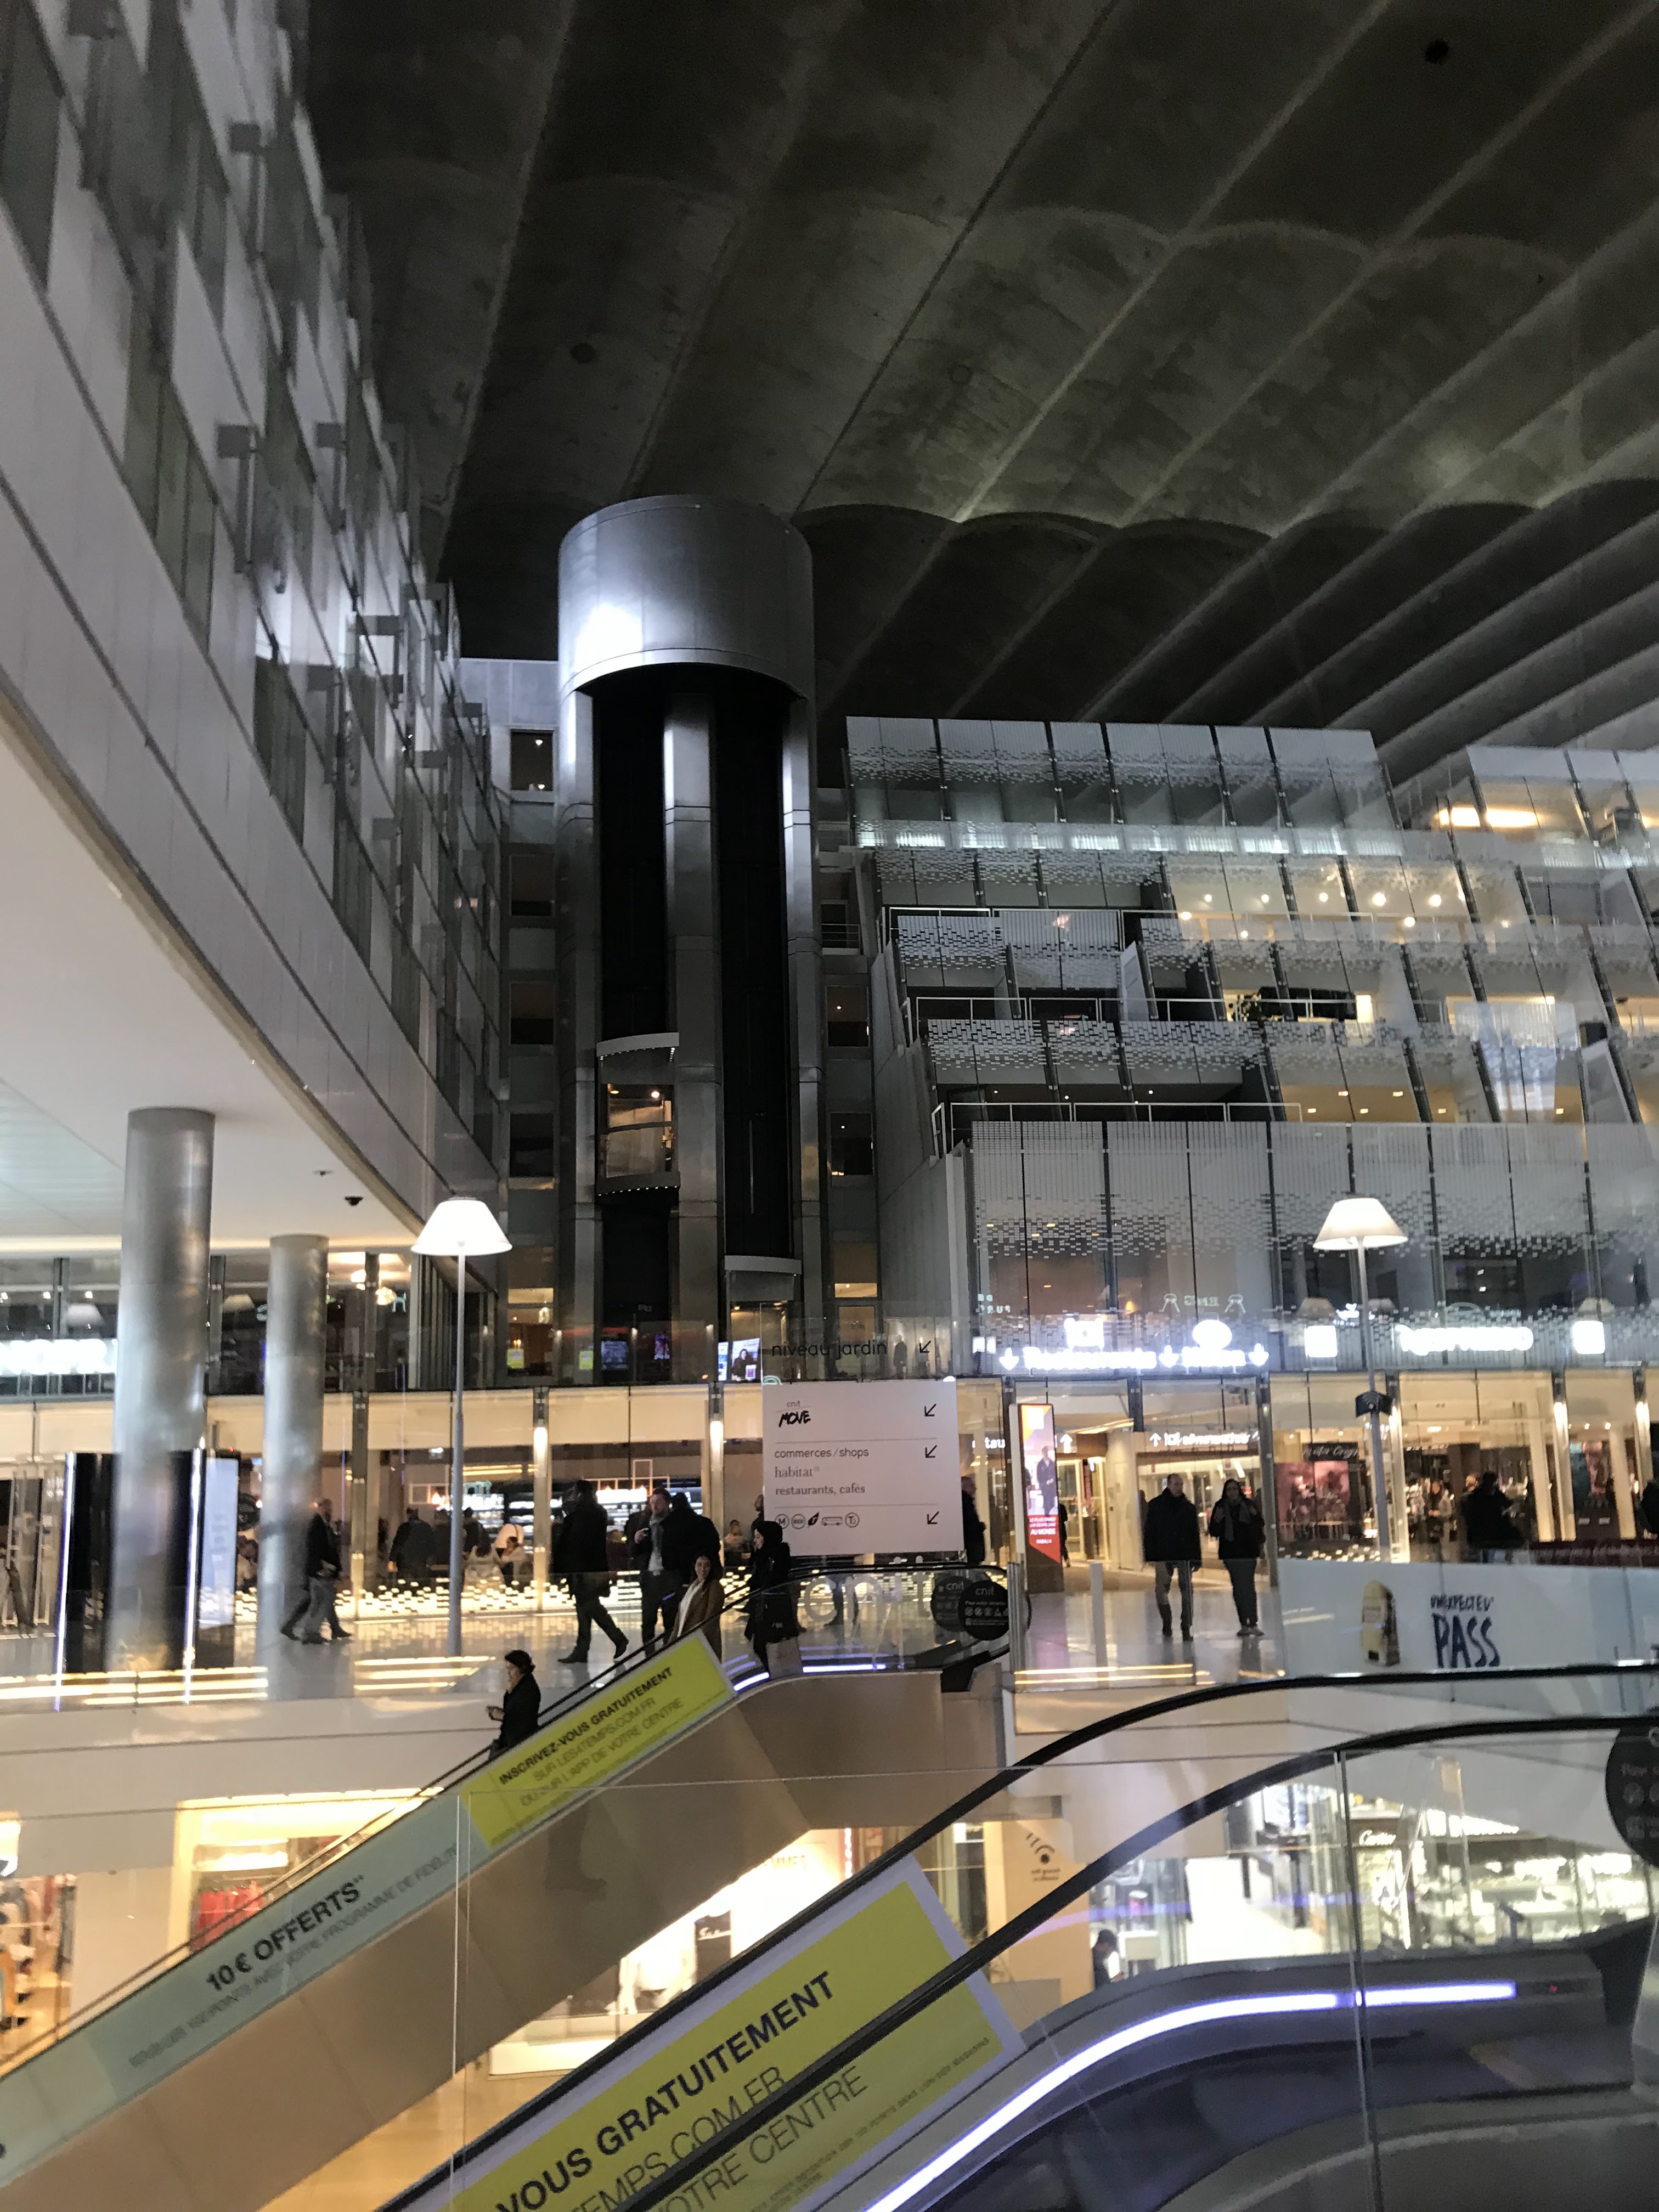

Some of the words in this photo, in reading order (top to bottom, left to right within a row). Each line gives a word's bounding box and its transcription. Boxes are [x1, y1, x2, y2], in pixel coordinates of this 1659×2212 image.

[772, 1341, 830, 1357] niveau
[836, 1339, 887, 1361] jardin
[778, 1410, 811, 1428] MOVE
[775, 1485, 837, 1496] restaurants,
[839, 1482, 866, 1494] cafés
[1431, 1612, 1501, 1669] PASS
[499, 1721, 590, 1785] INSCRIVEZ-VOUS
[590, 1666, 673, 1725] GRATUITEMENT
[641, 1696, 685, 1730] CENTRE
[596, 1971, 834, 2157] GRATUITEMENT
[657, 2152, 749, 2212] OTRE
[748, 2065, 868, 2164] CENTRE
